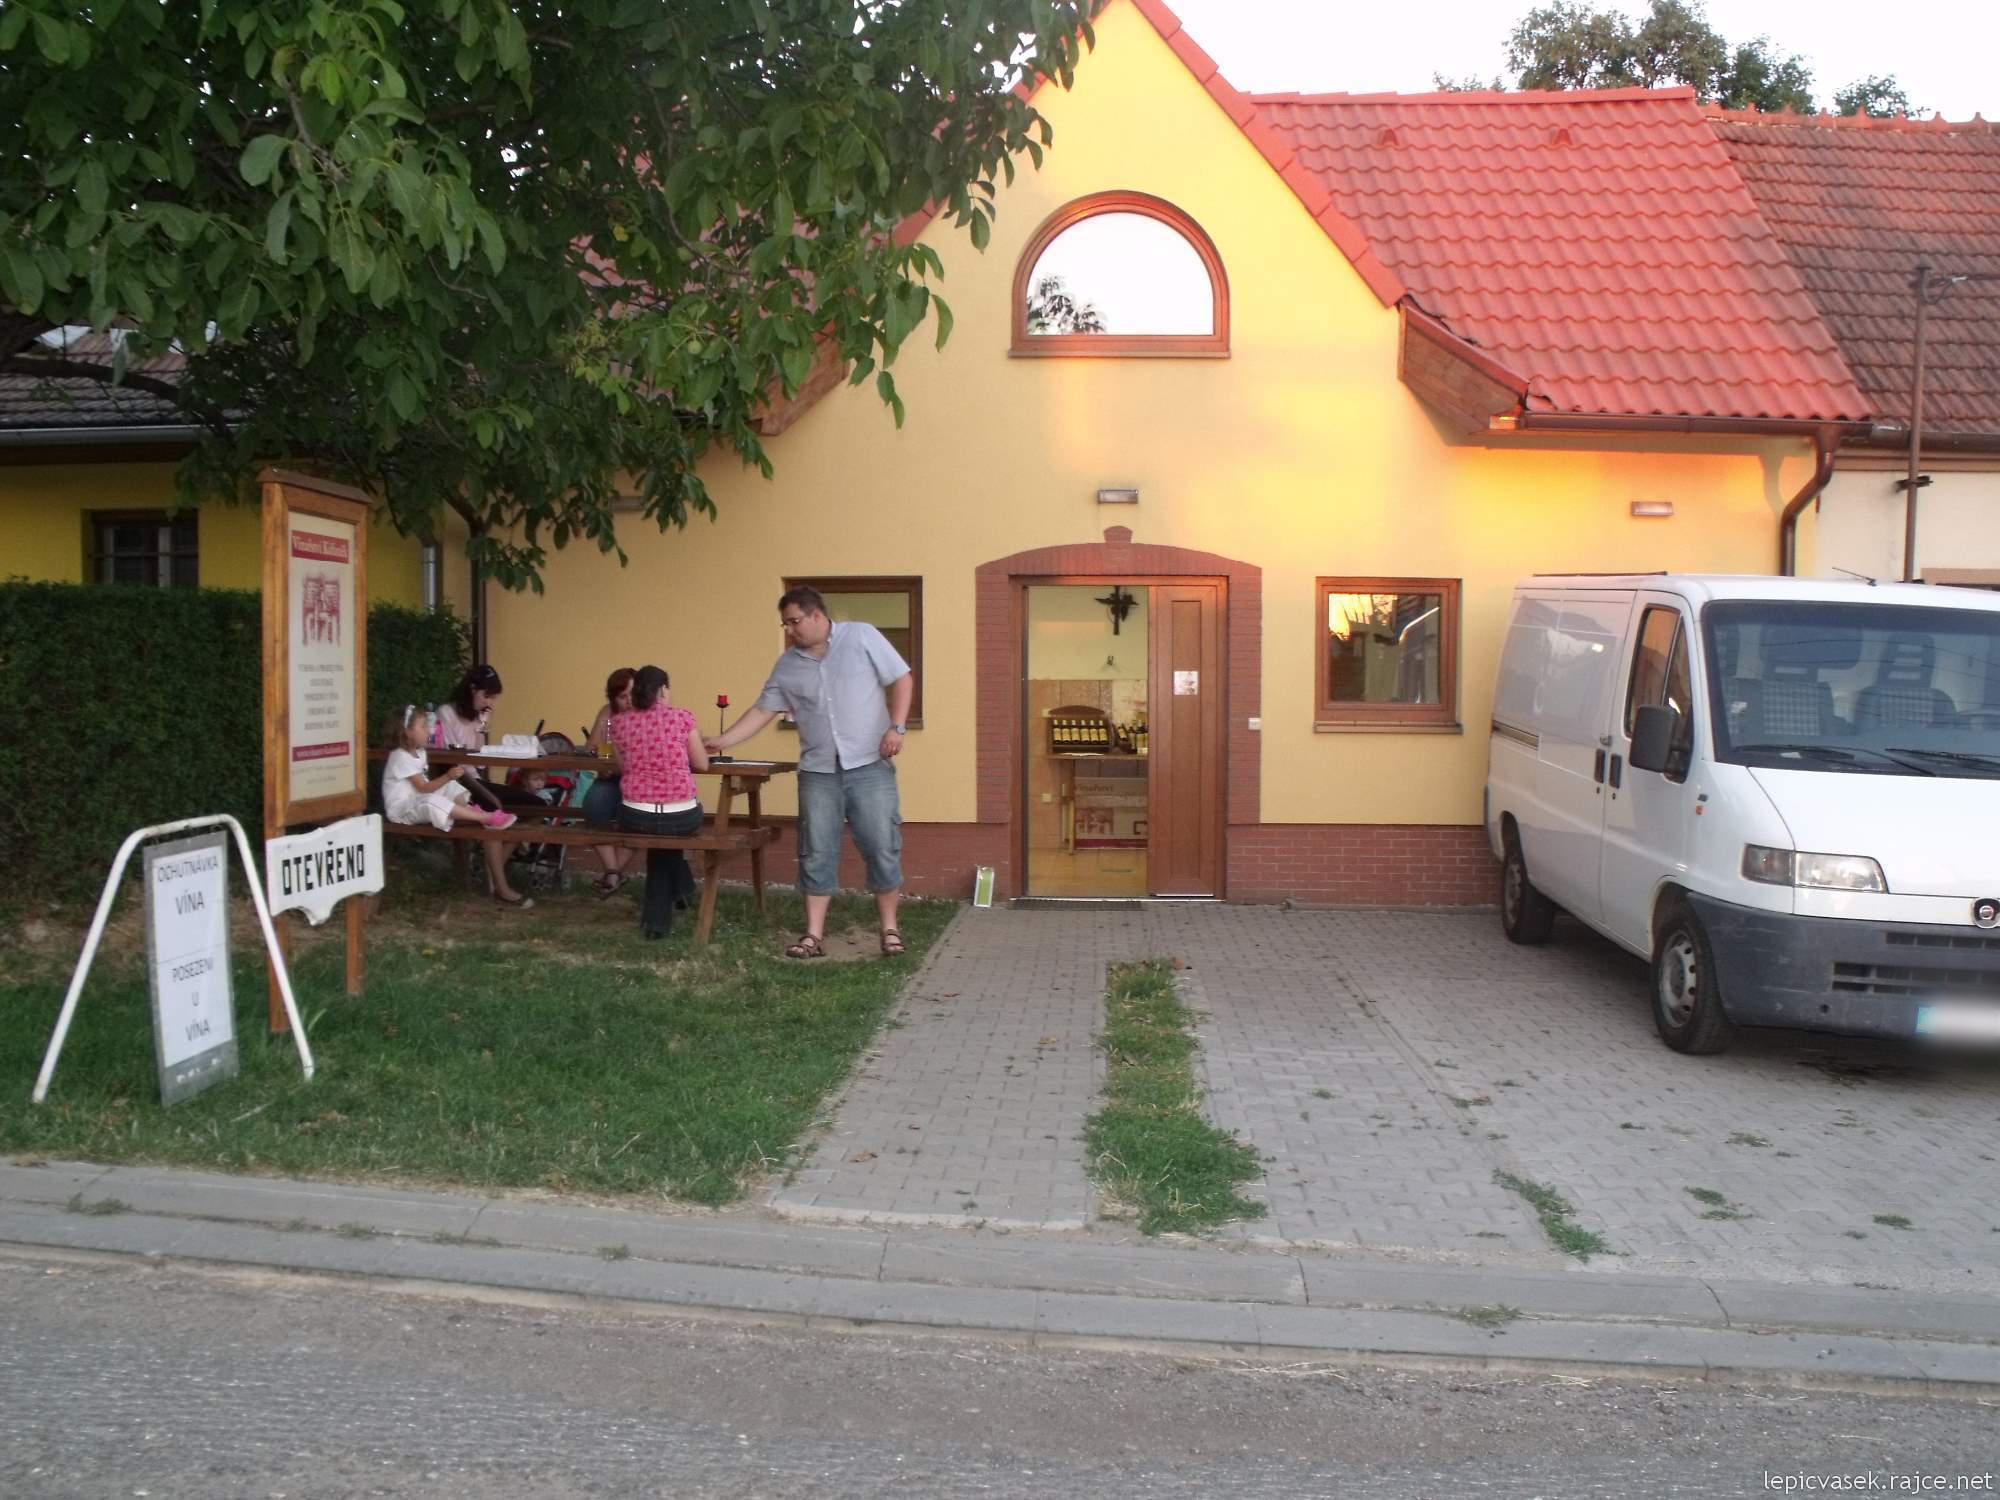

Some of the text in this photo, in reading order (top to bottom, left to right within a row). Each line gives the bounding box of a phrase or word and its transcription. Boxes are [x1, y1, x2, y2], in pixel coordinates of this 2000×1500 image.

[281, 841, 365, 896] OTEVŘENO
[175, 889, 206, 915] VÍNA
[191, 991, 200, 1007] U
[184, 1017, 211, 1041] VÍNA
